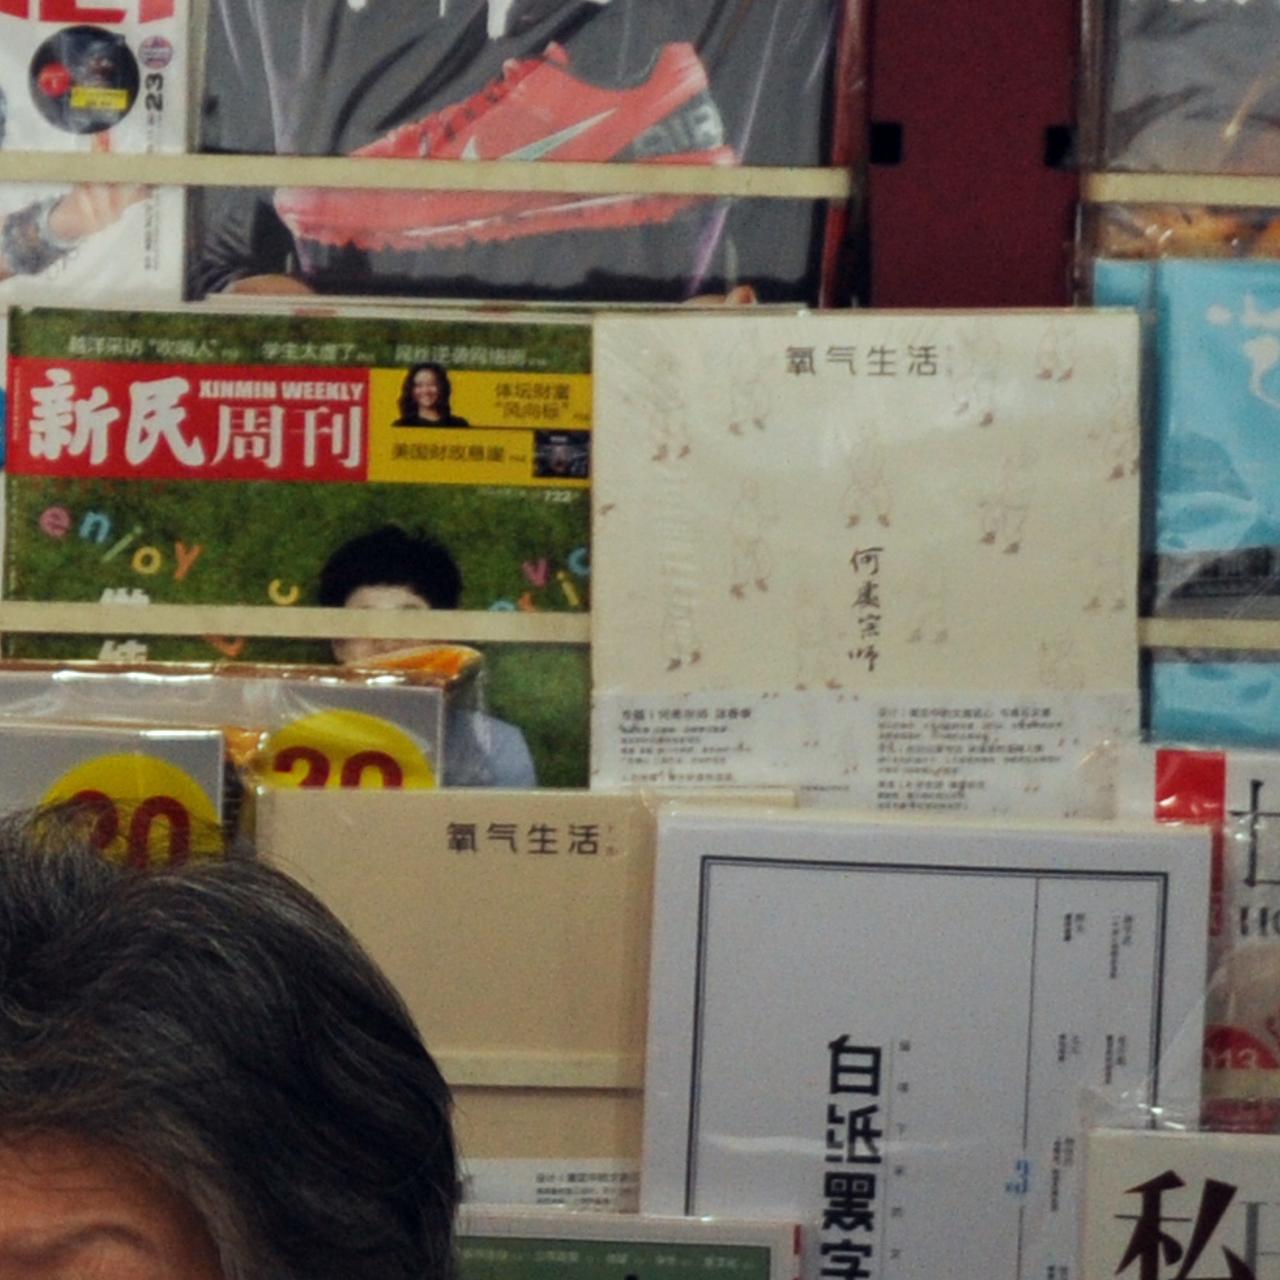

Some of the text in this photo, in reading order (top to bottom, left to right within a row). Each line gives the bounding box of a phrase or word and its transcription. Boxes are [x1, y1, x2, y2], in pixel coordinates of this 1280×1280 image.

[785, 344, 939, 377] 氧气生活
[198, 379, 365, 402] XINMIN WEEKLY
[27, 367, 364, 470] 新民 周刊
[447, 821, 603, 856] 氧气生活
